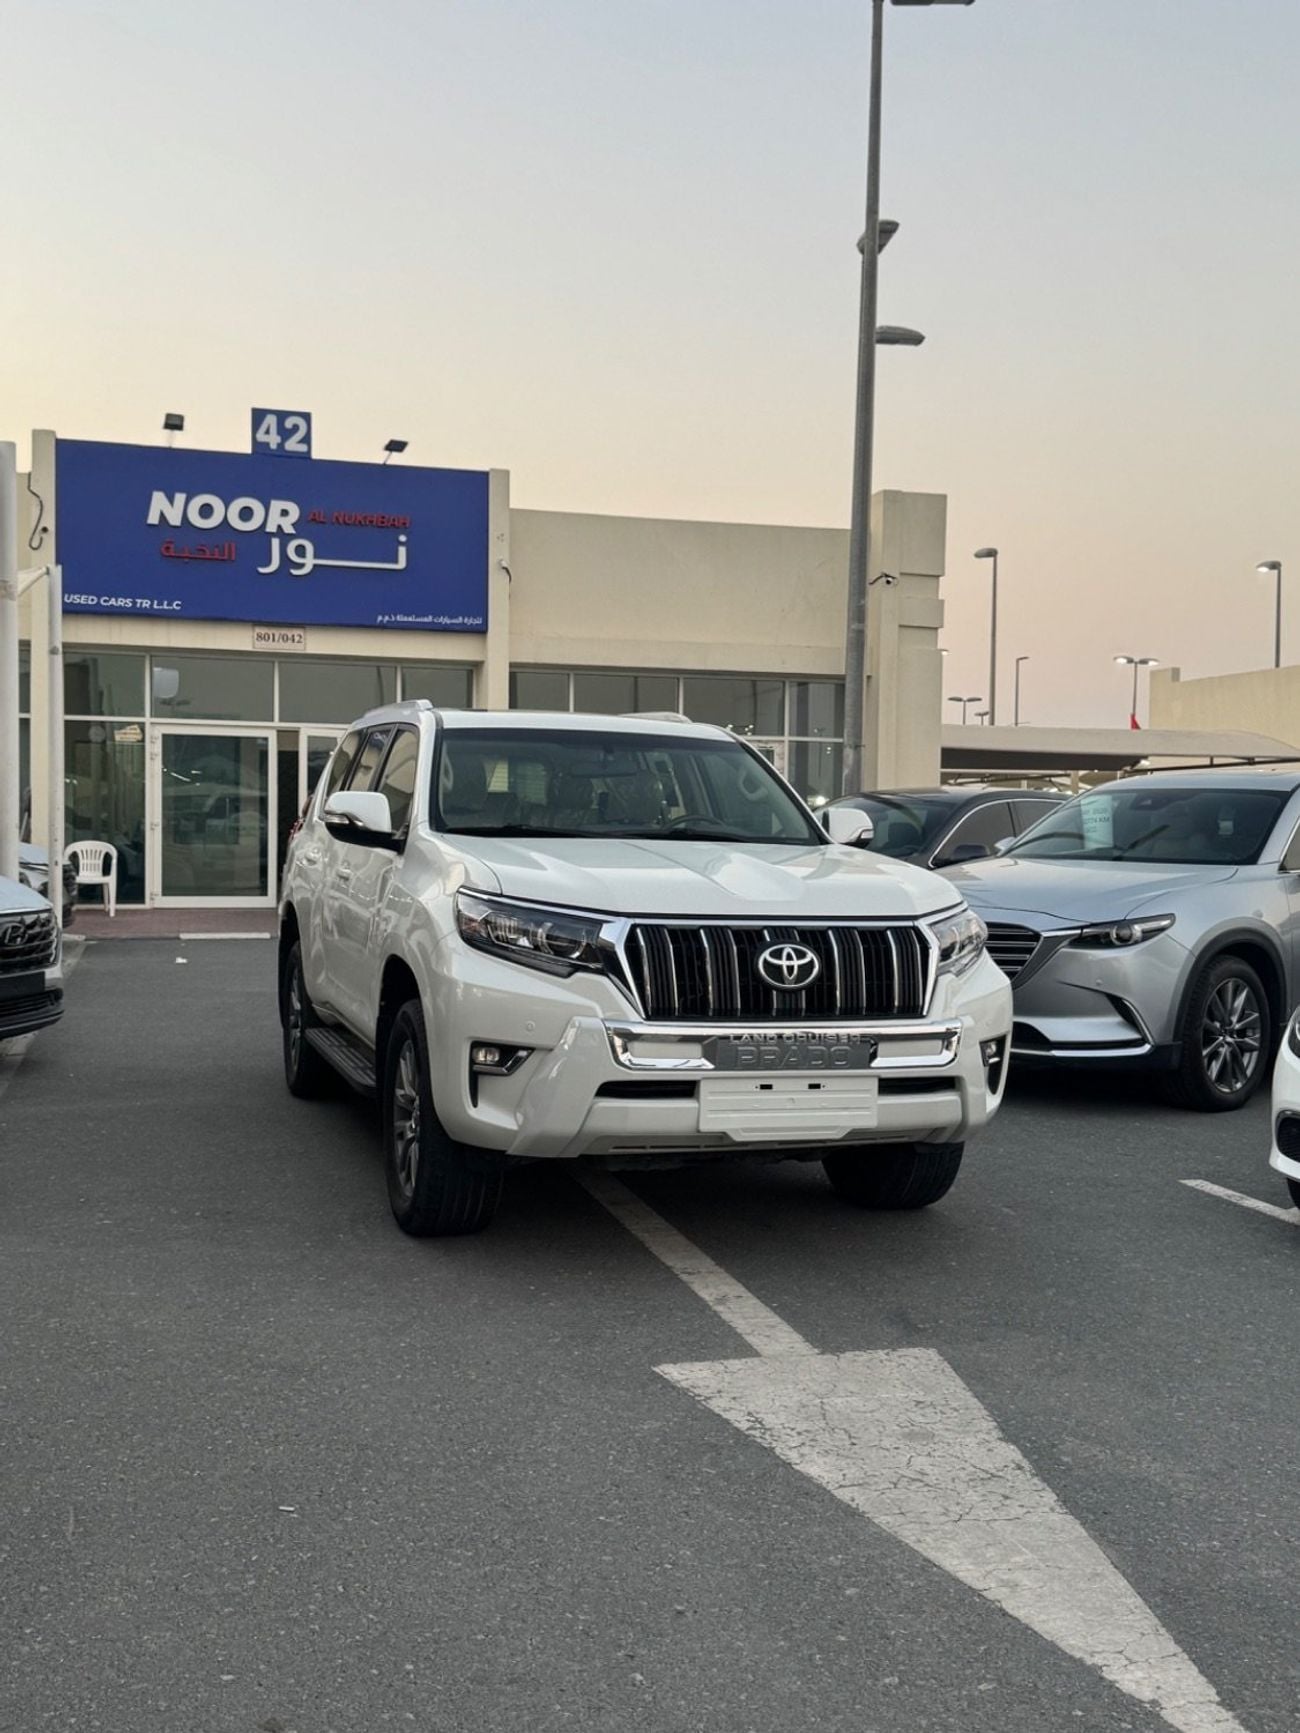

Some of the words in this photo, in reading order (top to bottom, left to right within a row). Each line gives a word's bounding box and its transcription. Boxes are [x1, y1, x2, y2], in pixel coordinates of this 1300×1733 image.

[256, 413, 308, 453] 42
[147, 491, 300, 533] NOOR
[308, 511, 327, 524] AL
[333, 512, 411, 529] NUKHBAH
[161, 539, 236, 563] النخبة
[257, 535, 408, 577] نور
[64, 594, 98, 605] USED
[100, 597, 133, 608] CARS
[135, 599, 151, 609] TR
[153, 600, 181, 610] L.L.C
[434, 615, 462, 624] السيارات
[256, 632, 303, 644] 801/042
[730, 1034, 778, 1045] LAND
[782, 1034, 861, 1045] CRUISER
[737, 1046, 852, 1068] PRADO
